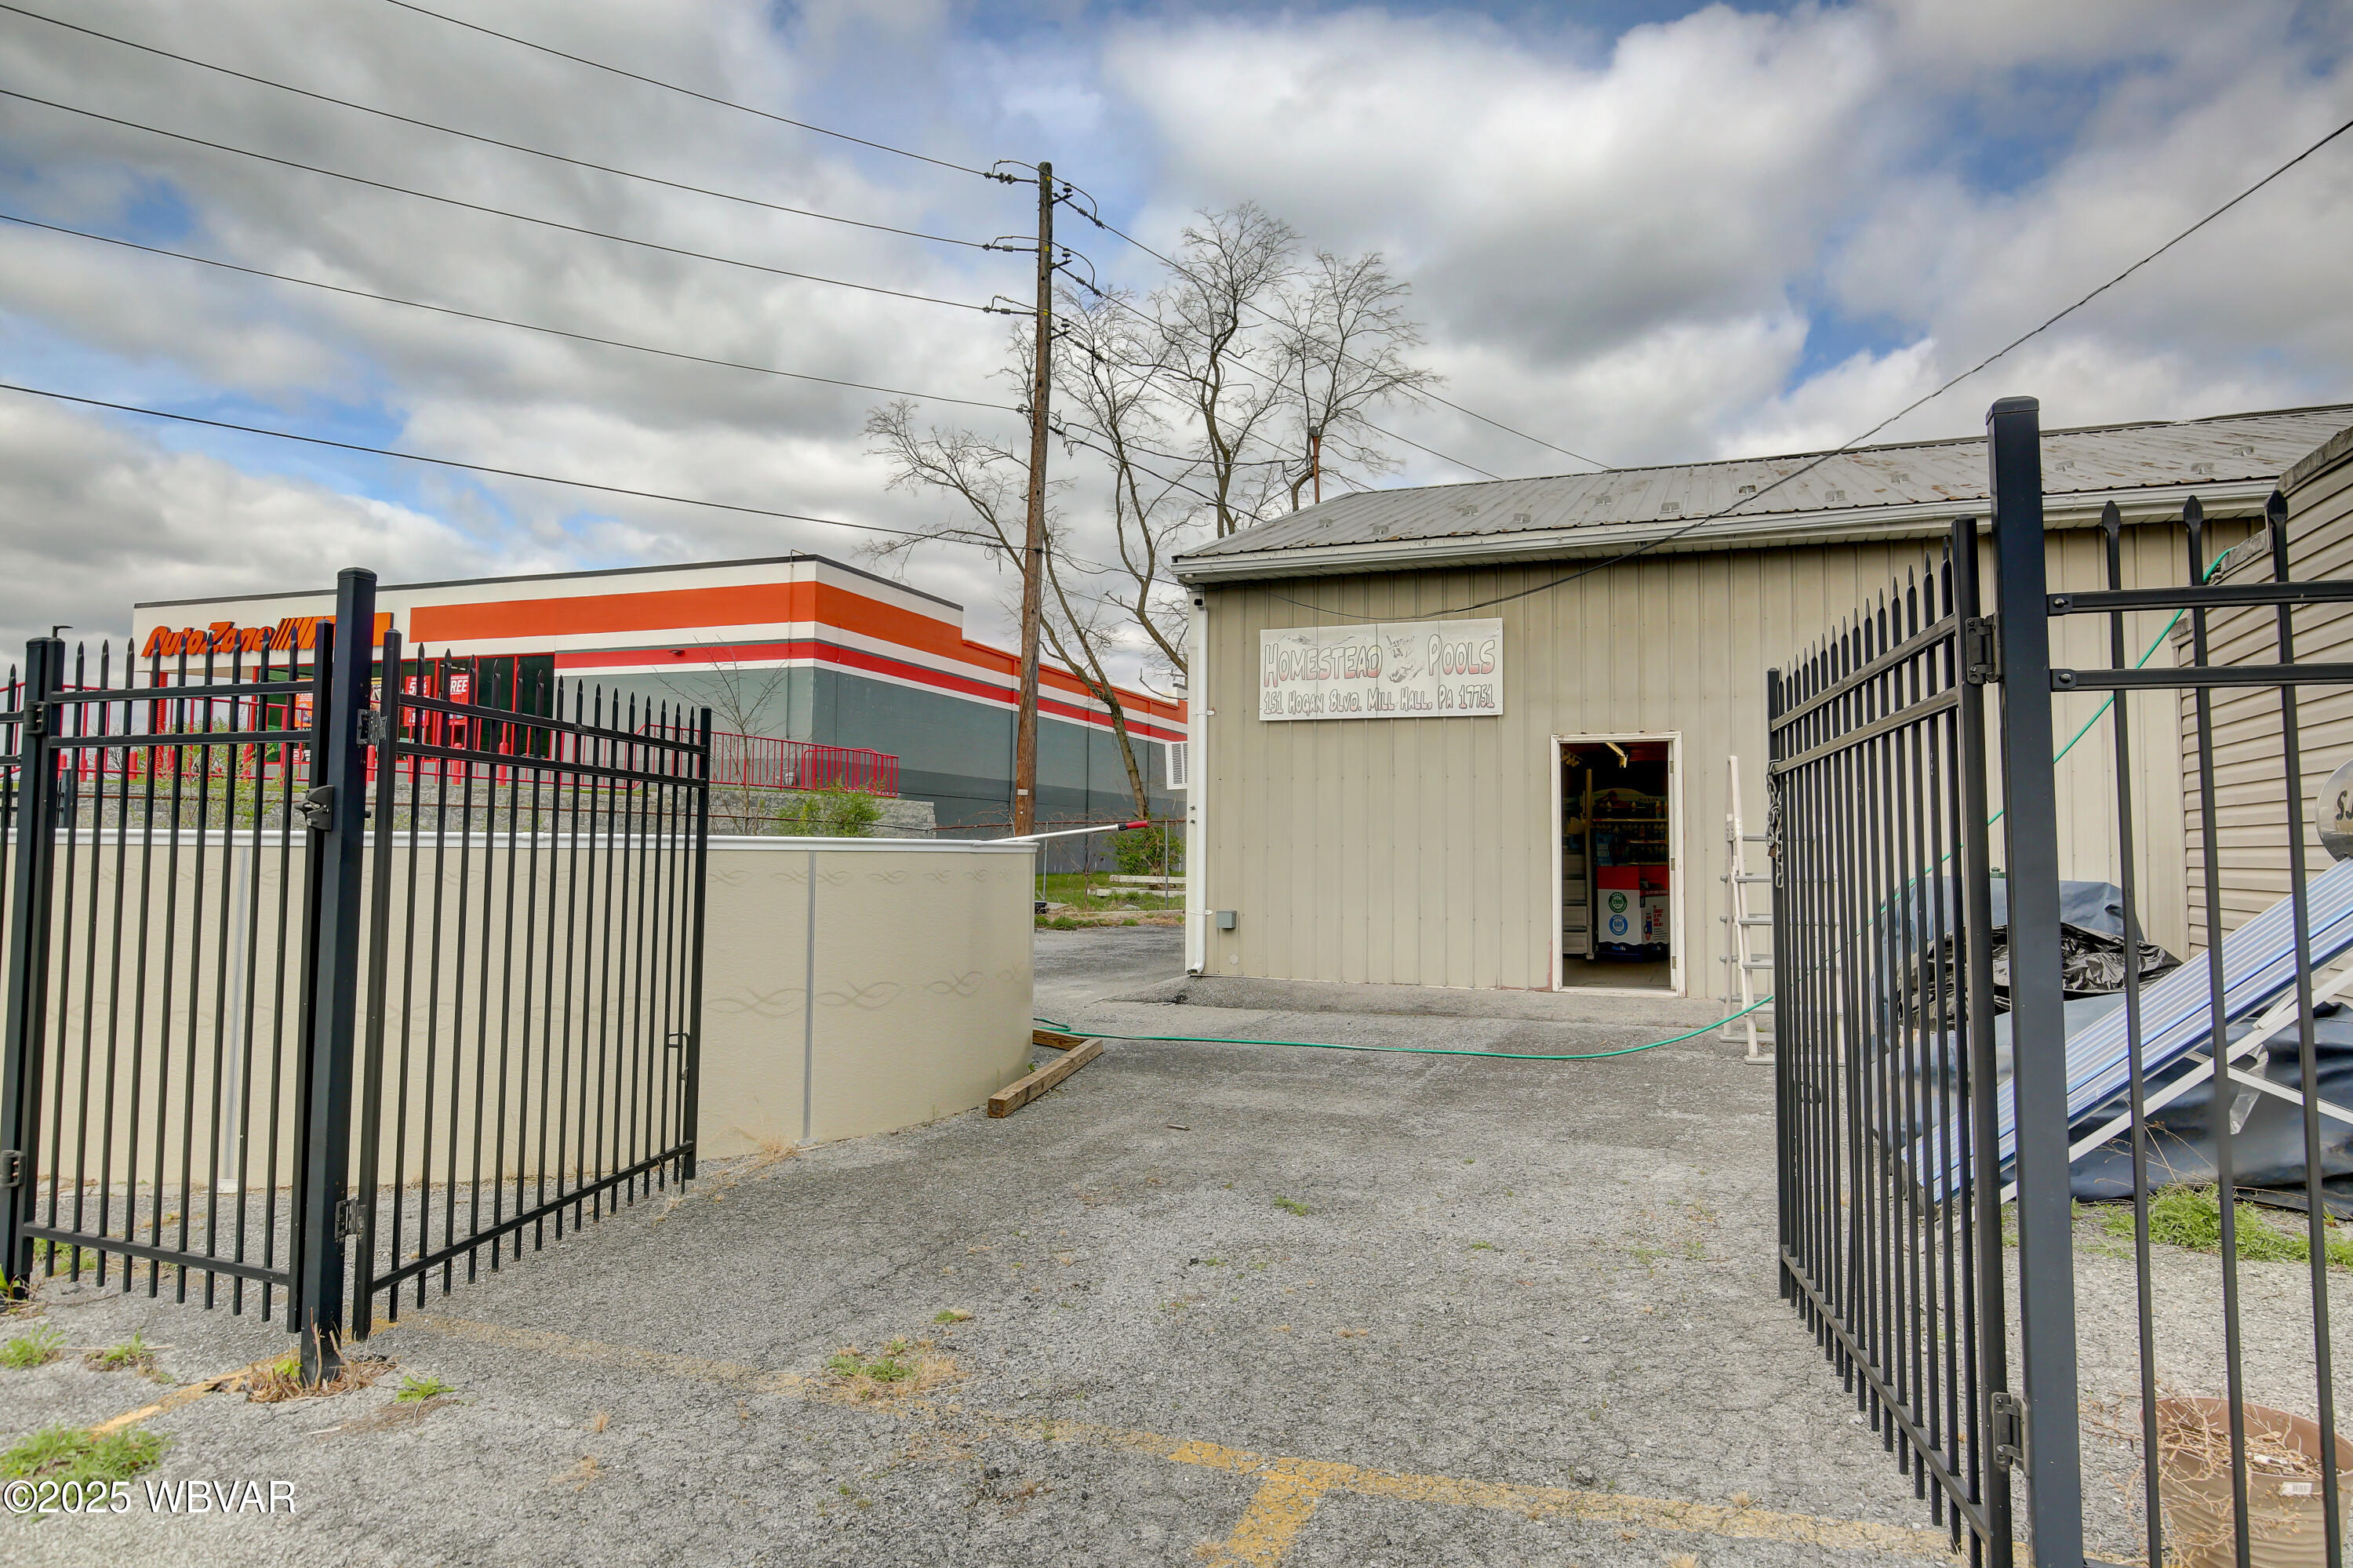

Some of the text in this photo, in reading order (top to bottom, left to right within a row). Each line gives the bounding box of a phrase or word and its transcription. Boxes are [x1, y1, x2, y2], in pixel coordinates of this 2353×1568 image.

[140, 621, 275, 657] AutoZone
[1264, 634, 1496, 688] HOMESTEAD POOLS
[449, 679, 467, 693] REE
[1264, 684, 1495, 716] 151 HOGAN BLVD. MILL HALL, PA 17751
